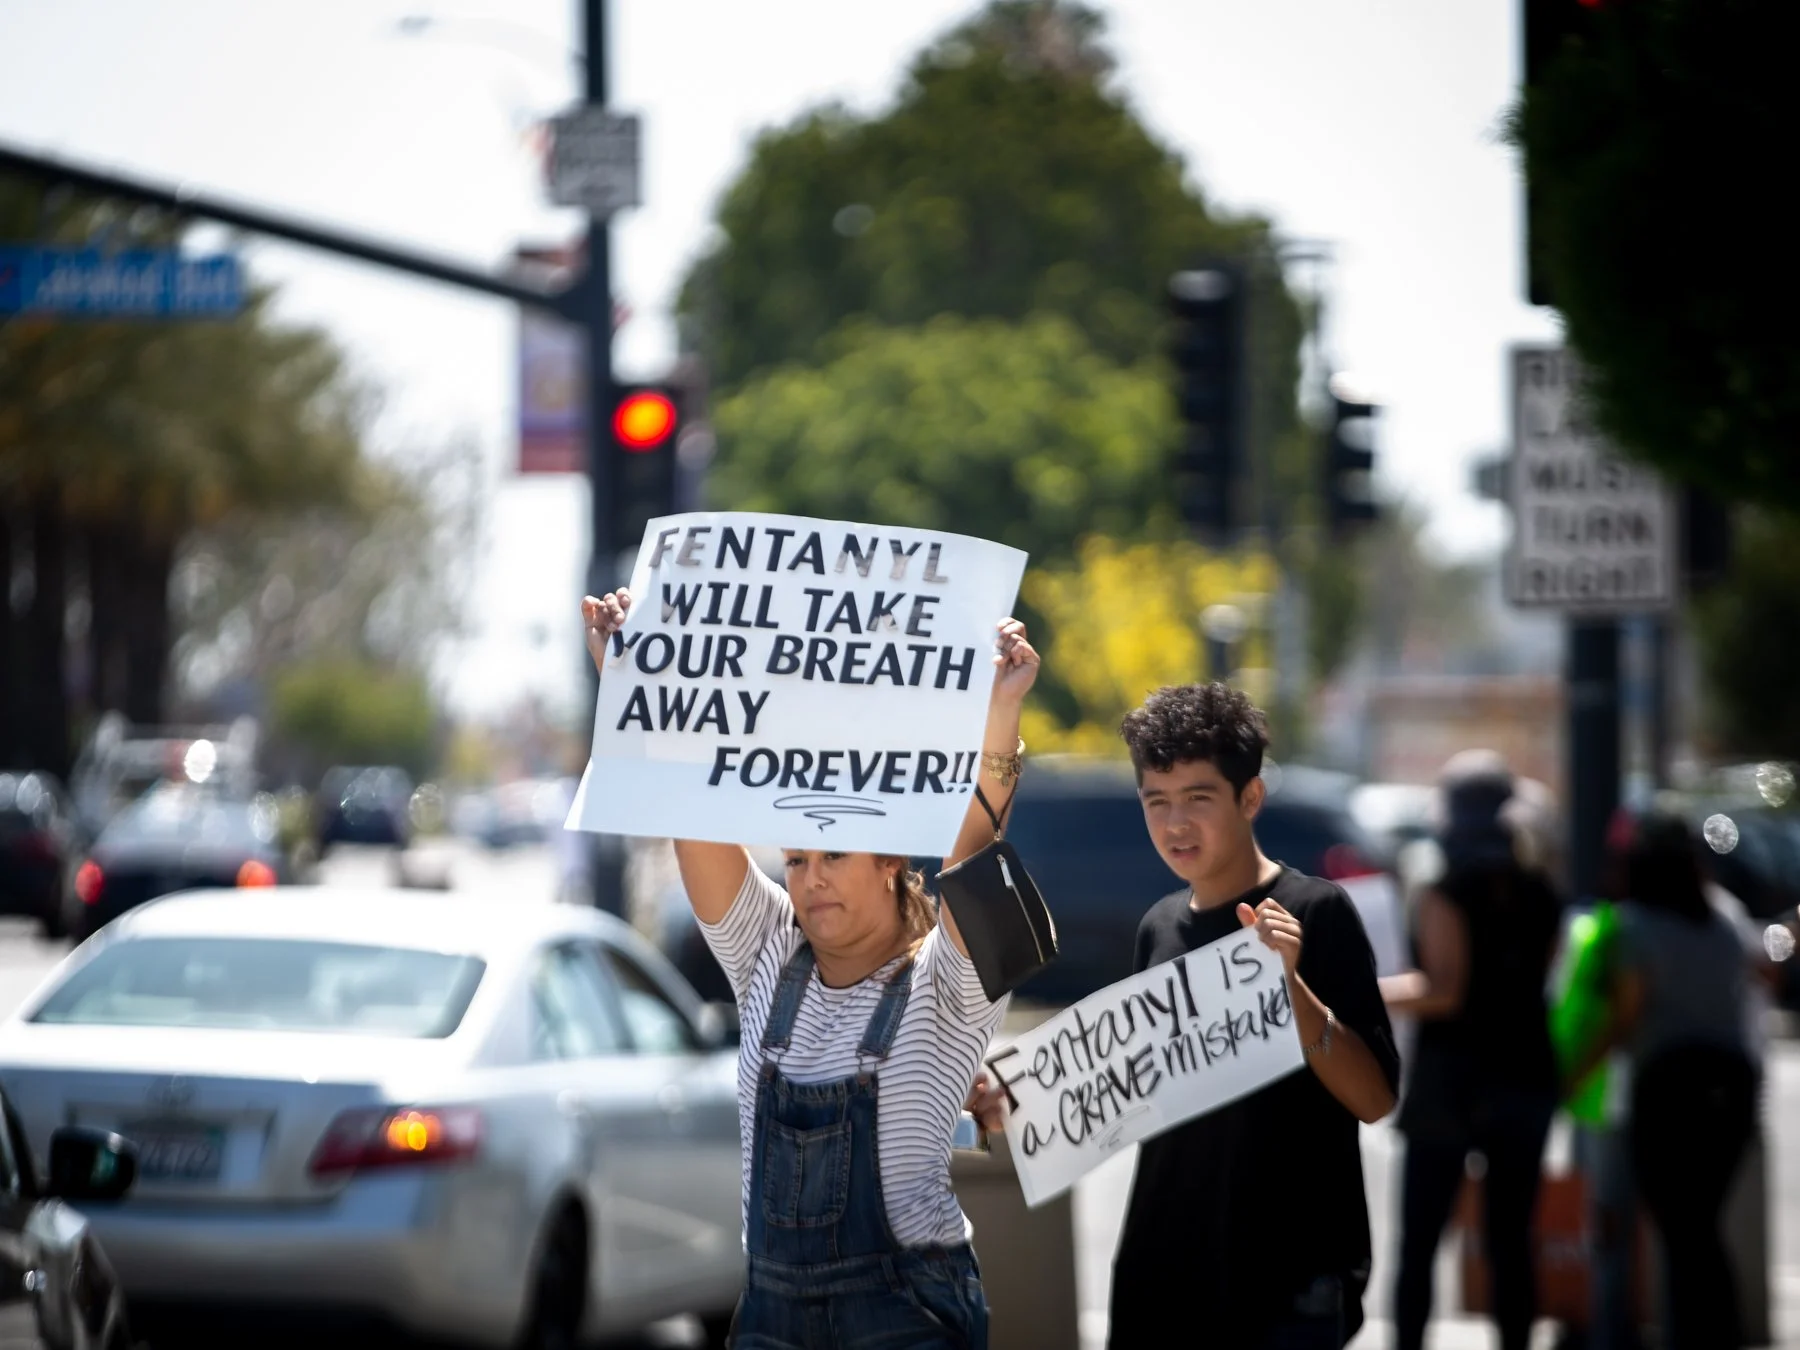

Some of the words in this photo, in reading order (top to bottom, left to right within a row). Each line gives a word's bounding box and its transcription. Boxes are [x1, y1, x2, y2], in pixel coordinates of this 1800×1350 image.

[648, 526, 949, 584] FENTANYL
[661, 581, 780, 629] WILL
[802, 587, 941, 638] TAKE
[608, 630, 748, 679] YOUR
[765, 634, 976, 691] BREATH
[616, 685, 770, 735] AWAY
[707, 746, 979, 795] FOREVER!!
[984, 956, 1199, 1116] Fentanyl
[1216, 941, 1263, 991] is
[1021, 1119, 1056, 1157] a
[1058, 1041, 1162, 1146] GRAVE
